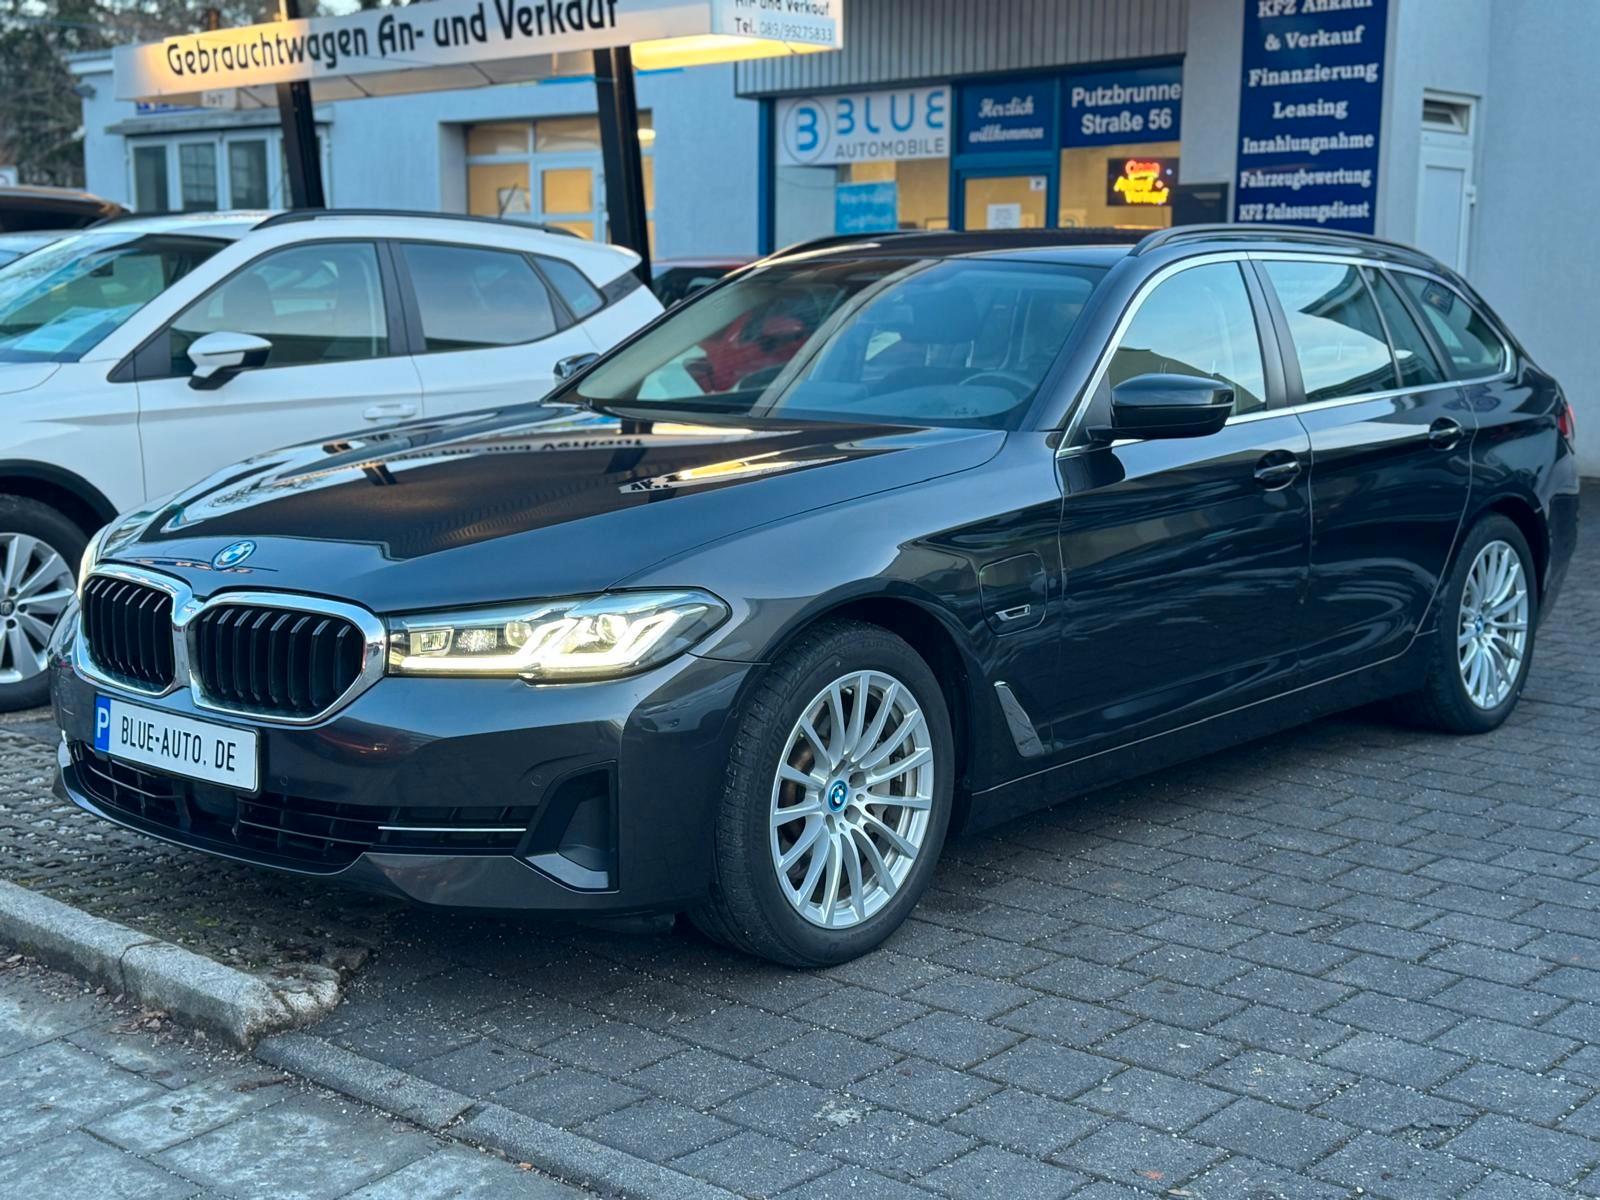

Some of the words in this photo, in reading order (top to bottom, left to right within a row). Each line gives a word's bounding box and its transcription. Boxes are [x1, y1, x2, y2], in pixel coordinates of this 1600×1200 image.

[735, 17, 757, 34] Tel.
[1264, 33, 1281, 51] &
[1285, 24, 1366, 49] Verkauf
[167, 24, 368, 76] Gebrauchtwagen
[378, 14, 424, 57] An-
[433, 2, 487, 47] und
[494, 0, 617, 39] Verkauf
[1248, 62, 1379, 87] Finanzierung
[836, 90, 945, 135] BLUE
[1272, 99, 1348, 119] Leasing
[1081, 110, 1143, 135] Straße
[1148, 108, 1172, 130] 56
[835, 137, 945, 158] AUTOMOBILE
[1242, 131, 1374, 155] Inzahlungnahme
[1240, 168, 1371, 190] Fahrzeugbewertung
[1239, 204, 1264, 221] KFZ
[1265, 201, 1370, 222] Zulassungsdienst
